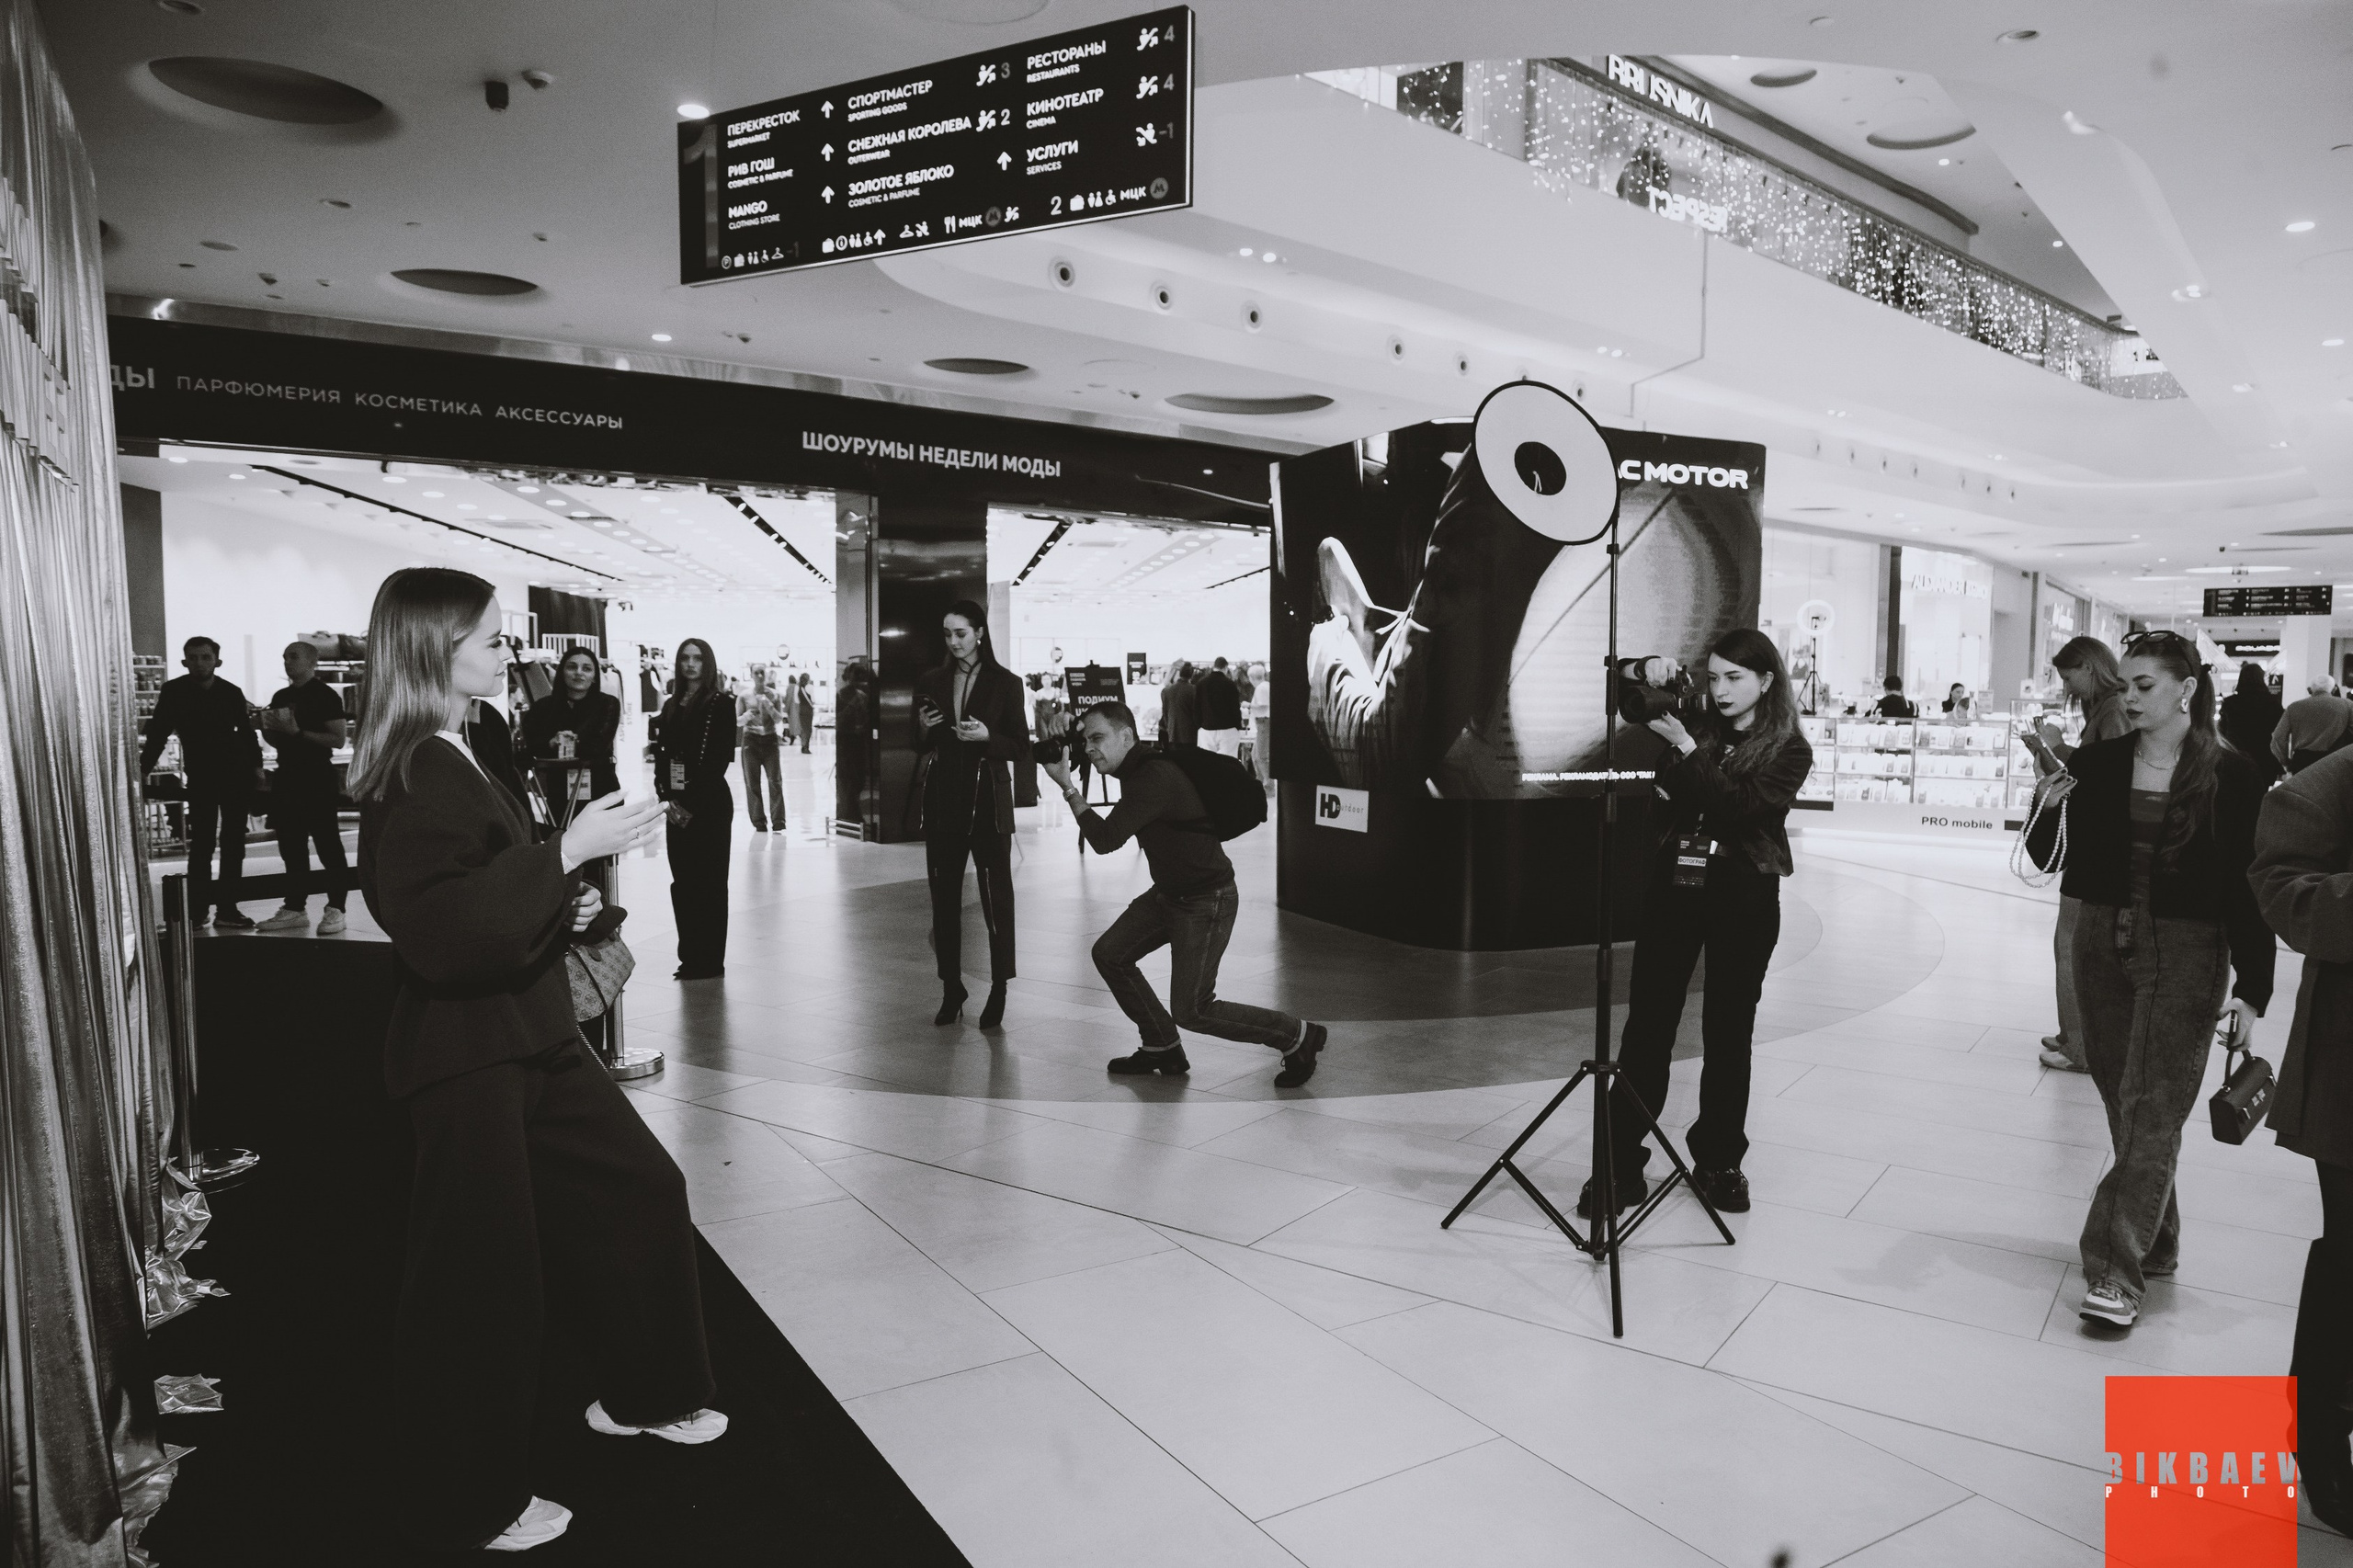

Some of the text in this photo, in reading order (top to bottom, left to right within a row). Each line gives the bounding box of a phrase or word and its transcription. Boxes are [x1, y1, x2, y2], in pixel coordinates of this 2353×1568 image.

[1164, 25, 1175, 42] 4
[1028, 40, 1106, 70] РЕСТОРАНЫ
[1001, 62, 1011, 79] 3
[1027, 64, 1080, 83] RESTAURANTS
[1164, 74, 1175, 91] 4
[847, 79, 933, 109] СПОРТМАСТЕР
[1027, 88, 1104, 116] КИНОТЕАТР
[847, 103, 908, 122] SPORTING GOODS
[1000, 108, 1011, 126] 2
[728, 110, 801, 136] ПЕРЕКРЕСТОК
[1026, 116, 1056, 129] CINEMA
[728, 132, 770, 149] SUPERMARKET
[847, 116, 972, 153] СНЕЖНАЯ КОРОЛЕВА
[847, 150, 890, 165] OUTERWEAR
[1027, 140, 1079, 162] УСЛУГИ
[728, 157, 775, 177] РИВ ГОШ
[1027, 161, 1062, 176] SERVICES
[728, 176, 759, 189] COSMETIC
[848, 165, 954, 196] ЗОЛОТОЕ ЯБЛОКО
[848, 195, 882, 208] COSMETIC
[890, 187, 920, 200] PARFUME
[1051, 195, 1063, 215] 2
[1120, 187, 1147, 200] МЦК
[728, 200, 767, 219] MANGO
[728, 213, 780, 230] CLOTHING STORE
[959, 215, 983, 228] МЦК
[176, 376, 341, 404] ПАРФЮМЕРИЯ
[355, 392, 483, 417] КОСМЕТИКА
[495, 404, 623, 430] АКСЕССУАРЫ
[802, 430, 1061, 479] ШОУРУМЫ НЕДЕЛИ МОДЫ
[1643, 461, 1748, 489] MOTOR
[1320, 792, 1341, 820] HD
[1921, 816, 1993, 829] PRO mobile
